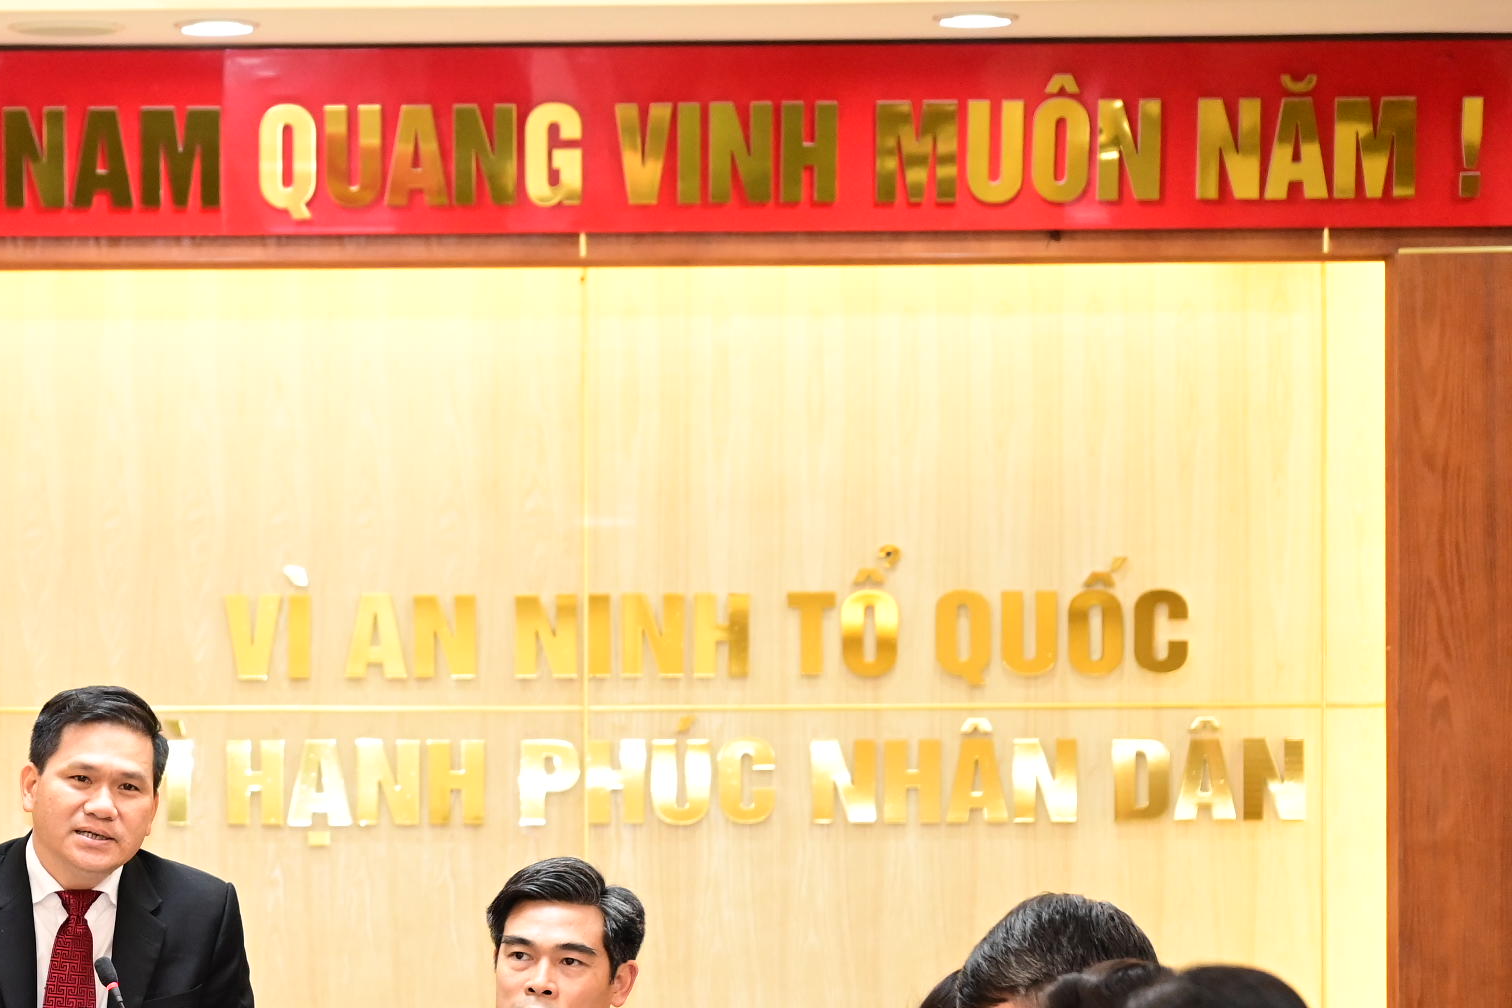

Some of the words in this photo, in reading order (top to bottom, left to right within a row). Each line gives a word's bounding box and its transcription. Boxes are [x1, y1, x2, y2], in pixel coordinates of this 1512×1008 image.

[1, 106, 221, 211] NAM
[257, 101, 584, 221] QUANG
[615, 99, 839, 205] VINH
[875, 73, 1162, 204] MUÔN
[1196, 73, 1417, 202] NĂM
[1459, 95, 1485, 199] !
[224, 563, 312, 681] VÌ
[344, 592, 478, 681] AN
[513, 591, 752, 681] NINH
[786, 543, 902, 679] TỔ
[934, 555, 1190, 687] QUỐC
[165, 719, 195, 826] Ì
[224, 737, 487, 848] HẠNH
[518, 714, 776, 828] PHÚC
[809, 716, 1079, 826] NHÂN
[1110, 714, 1306, 823] DÂN
